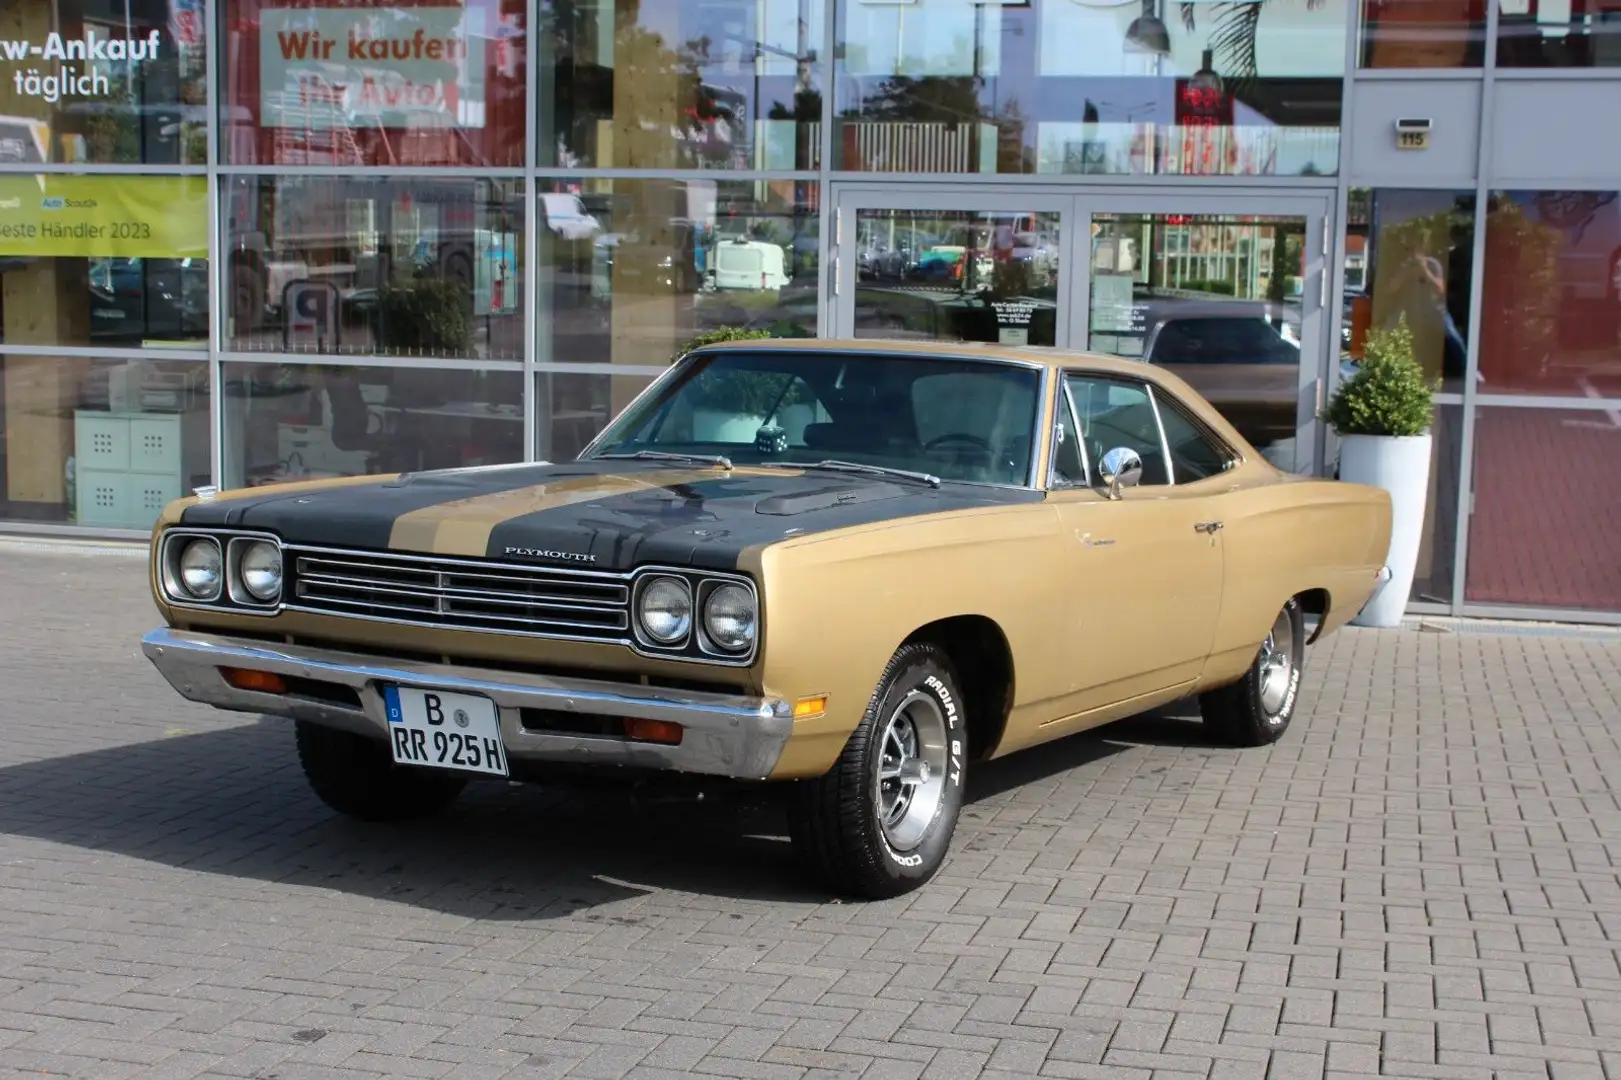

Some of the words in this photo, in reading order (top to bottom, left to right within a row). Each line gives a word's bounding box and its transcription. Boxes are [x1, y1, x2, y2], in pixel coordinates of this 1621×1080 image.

[277, 30, 335, 60] Wir
[347, 28, 467, 60] kaufen
[13, 65, 109, 102] täglich
[1401, 131, 1424, 146] 115
[41, 222, 105, 239] Händler
[110, 222, 151, 240] 2023
[504, 546, 597, 562] PLYMOUTH
[391, 708, 399, 718] D
[424, 693, 444, 726] B
[393, 727, 428, 762] RR
[924, 675, 959, 730] RADIAL
[949, 740, 962, 787] G/T
